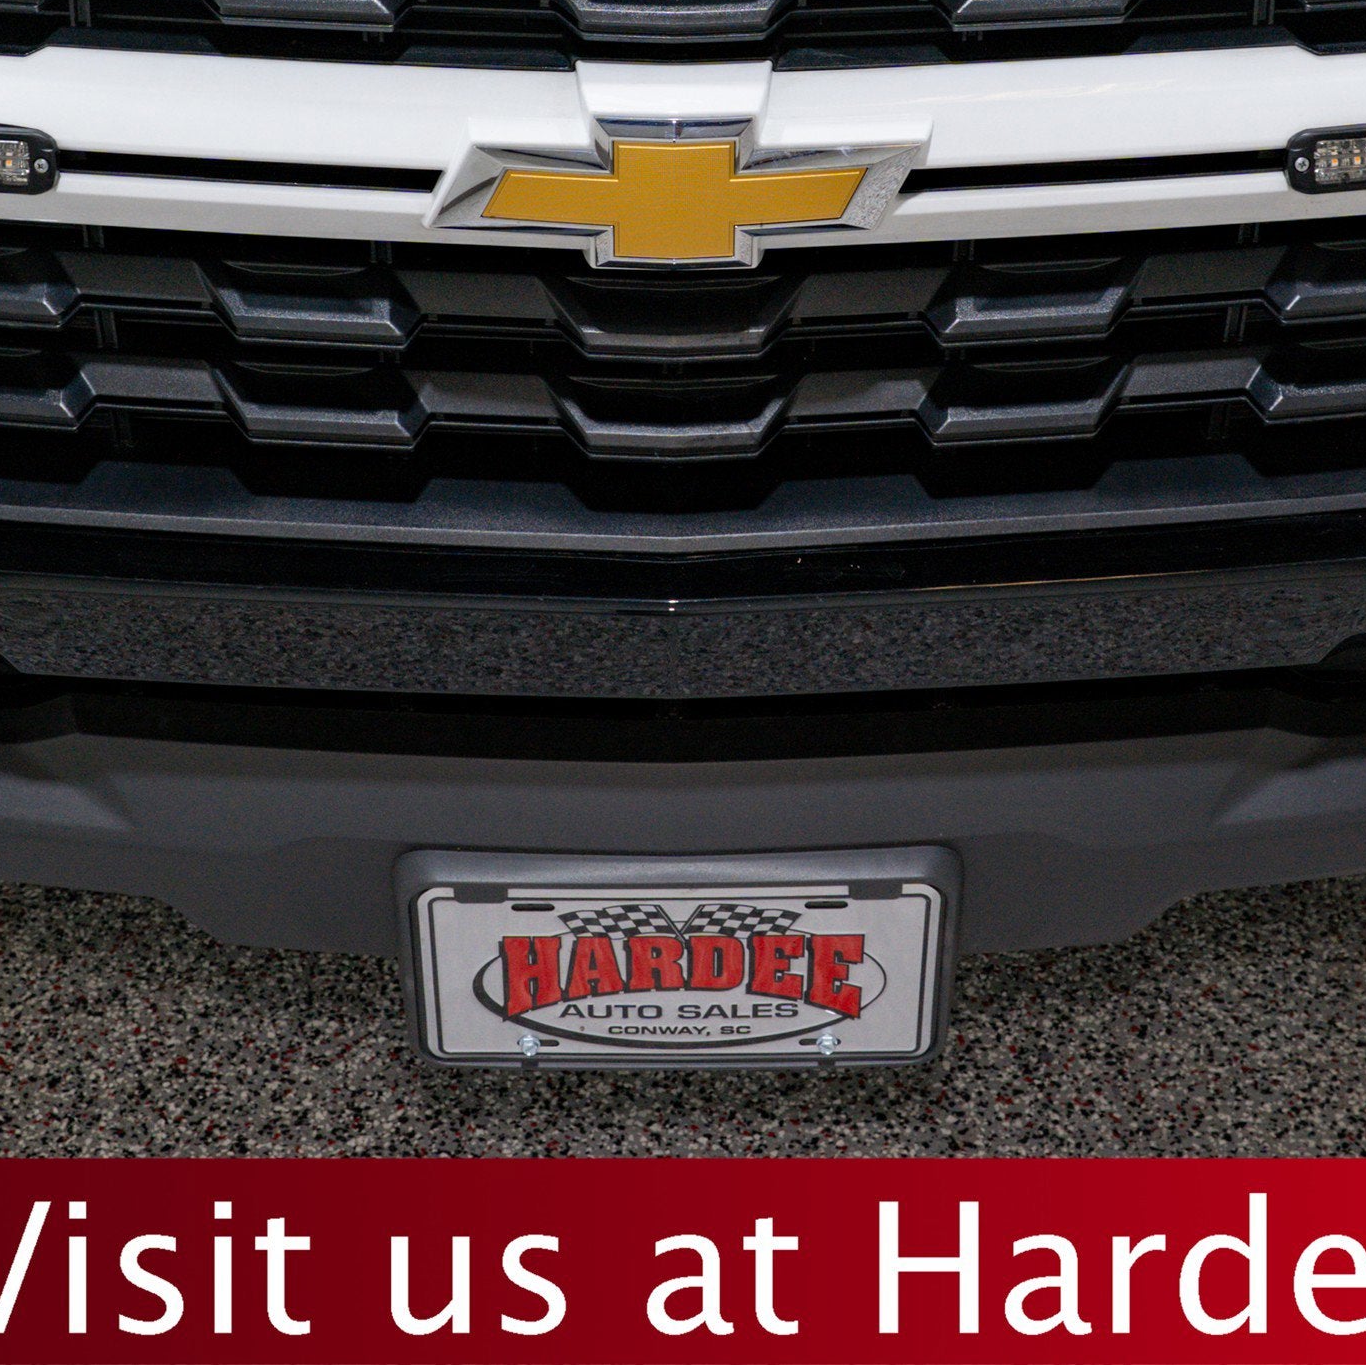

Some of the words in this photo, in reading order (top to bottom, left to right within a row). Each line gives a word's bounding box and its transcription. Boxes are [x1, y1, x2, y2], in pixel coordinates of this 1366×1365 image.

[498, 934, 865, 1021] HARDEE
[559, 1003, 663, 1020] AUTO
[677, 1002, 799, 1020] SALES
[608, 1024, 711, 1037] CONWAY,
[720, 1024, 752, 1036] SC
